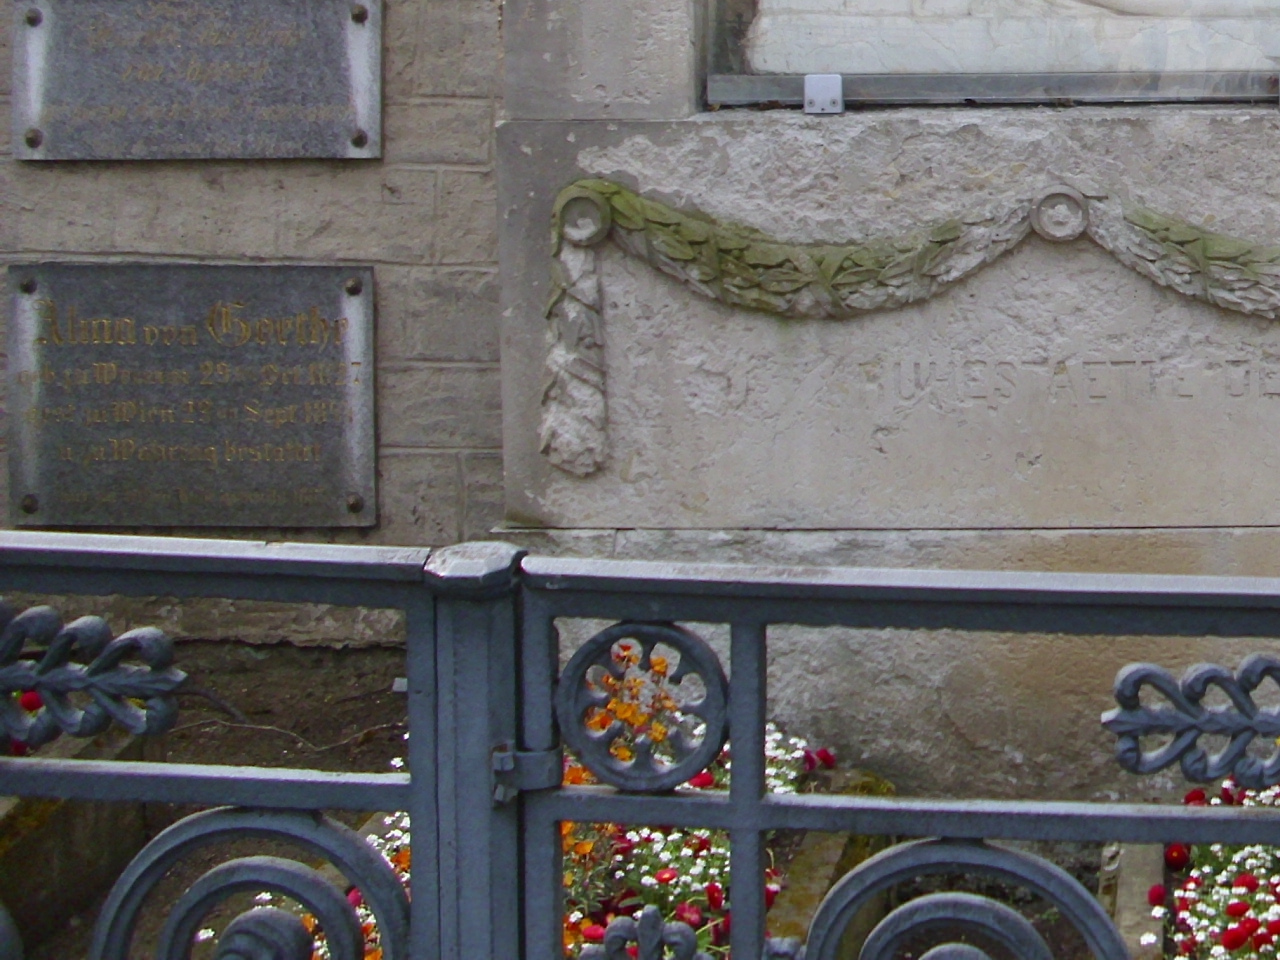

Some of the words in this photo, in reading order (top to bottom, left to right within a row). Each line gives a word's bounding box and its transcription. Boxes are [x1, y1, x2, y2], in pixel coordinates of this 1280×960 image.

[33, 296, 139, 347] Alma
[143, 320, 200, 347] von
[206, 299, 351, 353] Goethe
